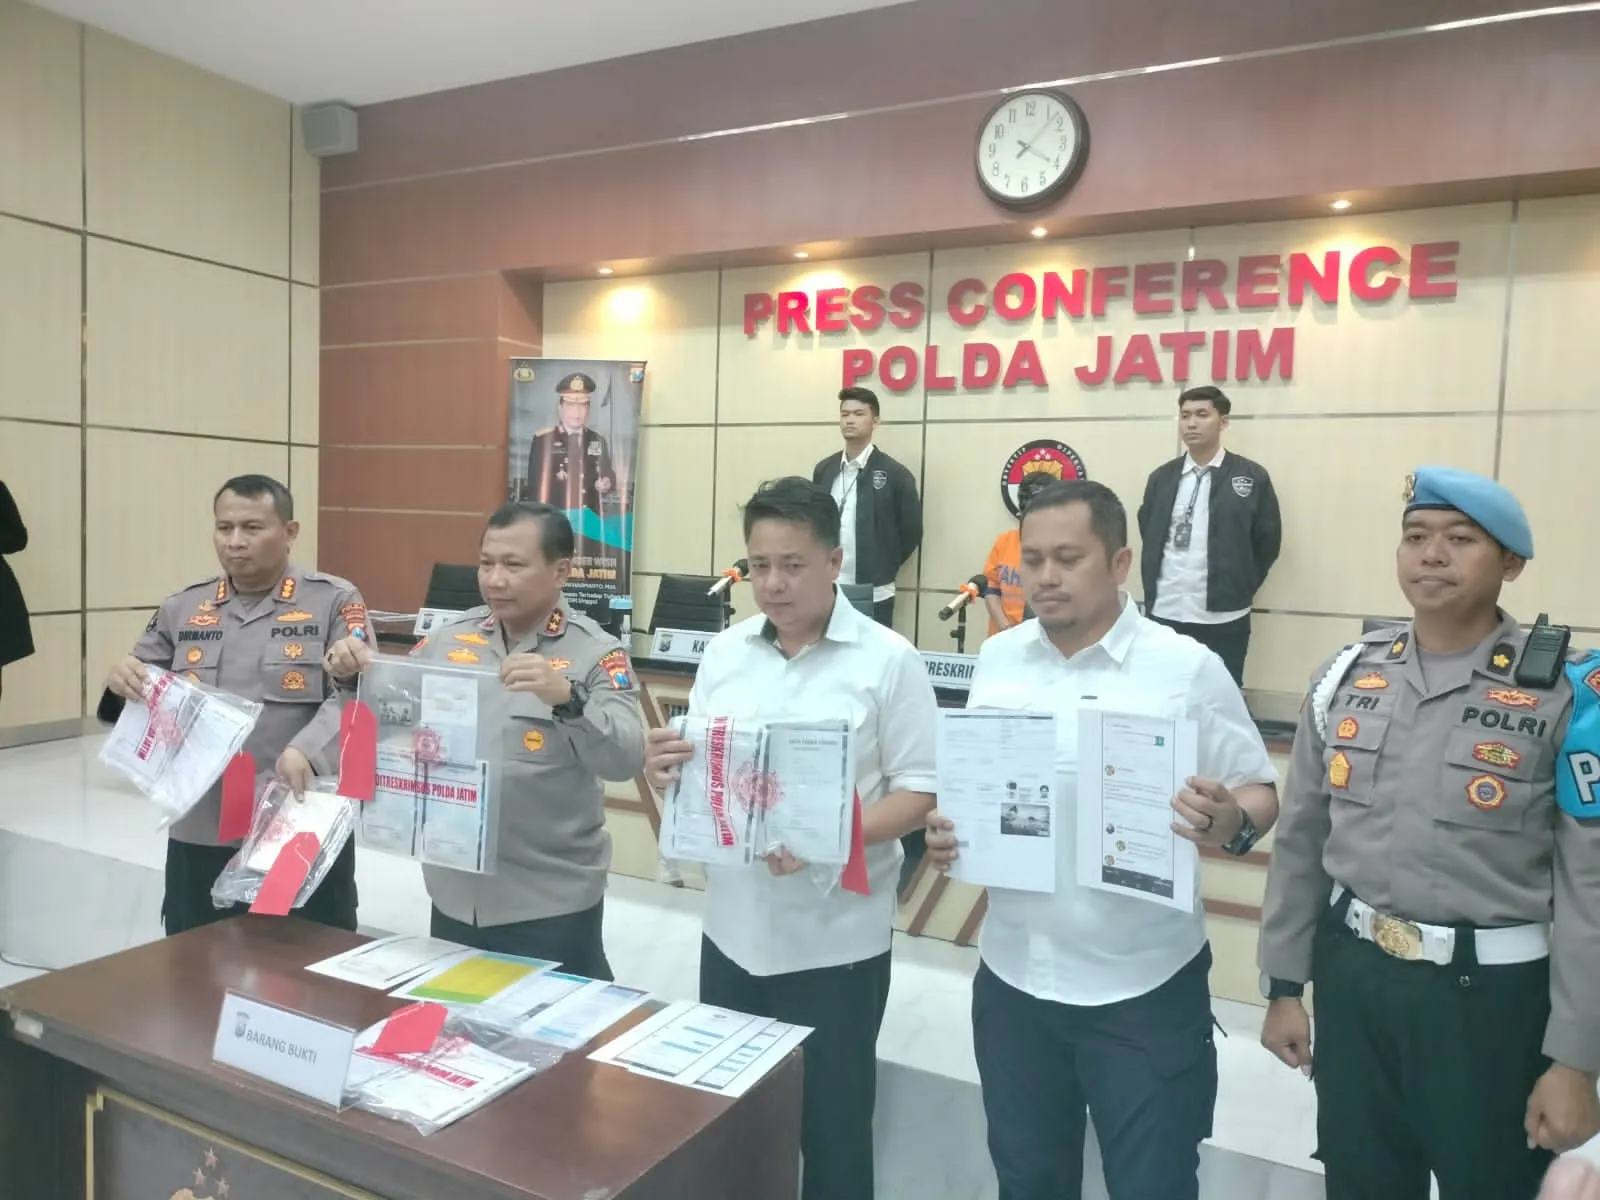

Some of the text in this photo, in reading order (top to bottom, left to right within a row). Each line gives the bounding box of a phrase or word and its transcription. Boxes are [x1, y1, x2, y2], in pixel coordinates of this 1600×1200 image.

[1009, 108, 1016, 123] 11
[1025, 101, 1036, 116] 12
[1056, 115, 1063, 132] 2
[994, 124, 1004, 140] 10
[989, 143, 996, 158] 9
[992, 161, 999, 176] 8
[1005, 173, 1011, 189] 7
[1021, 177, 1028, 192] 6
[744, 241, 1461, 336] PRESS CONFERENCE
[842, 327, 1295, 392] POLDA JATIM
[271, 625, 319, 638] POLRI
[925, 660, 975, 680] RESKRI
[1346, 694, 1380, 710] TRI
[1462, 706, 1548, 738] POLRI
[432, 783, 455, 799] POLDA
[456, 786, 477, 803] JATIM
[246, 1029, 317, 1064] BARANG BUKTI
